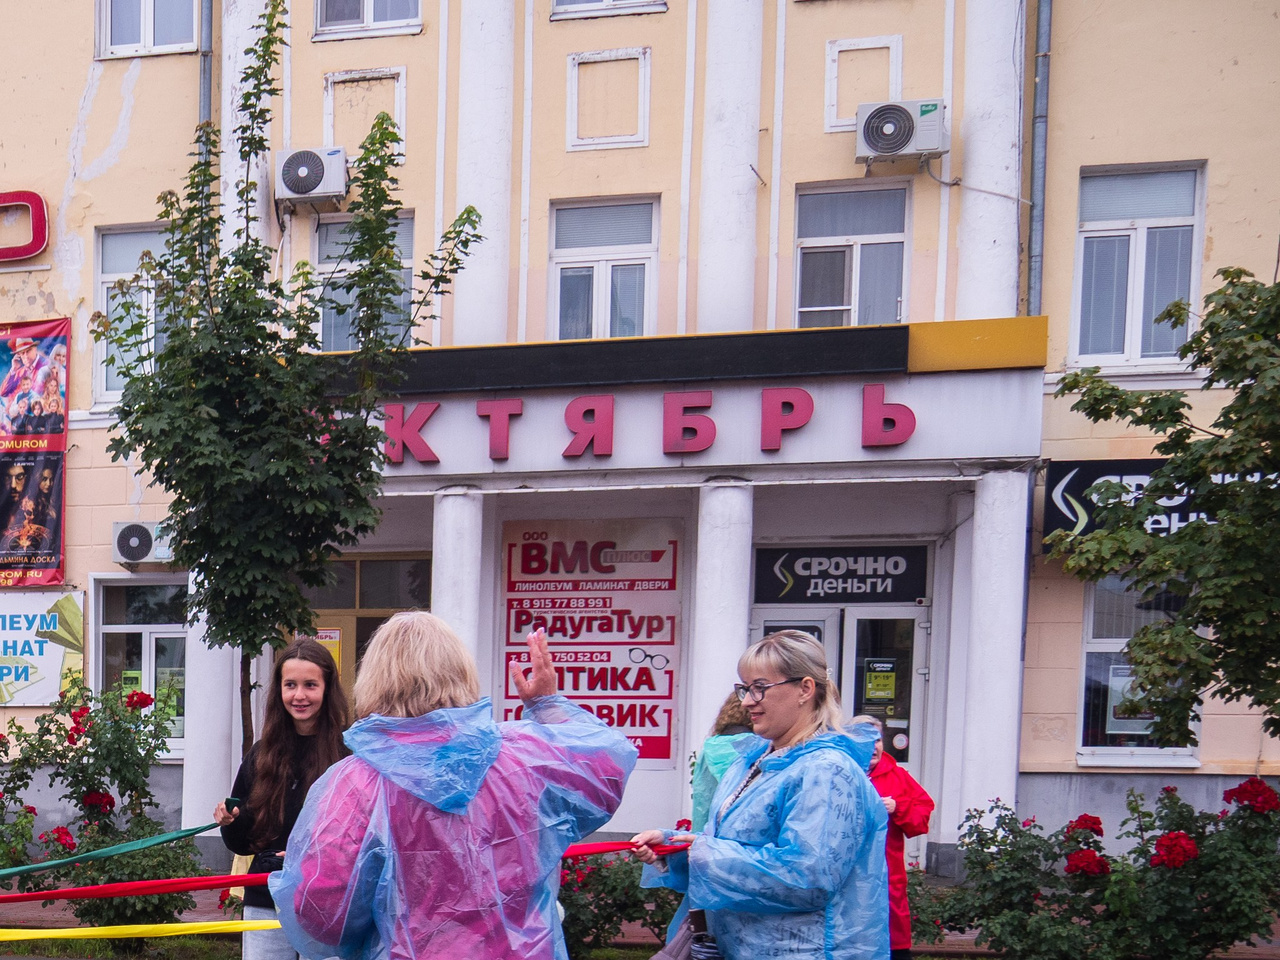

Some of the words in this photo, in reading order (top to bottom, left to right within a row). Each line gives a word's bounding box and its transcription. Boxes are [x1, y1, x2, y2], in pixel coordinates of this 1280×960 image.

[302, 382, 918, 465] КТЯБРЬ
[523, 531, 548, 541] ООО
[521, 540, 617, 574] ВМС
[606, 551, 651, 563] ПЛЮС
[794, 556, 907, 576] СРОЧНО
[514, 582, 573, 591] ЛИНОЛЕУМ
[578, 581, 631, 590] ЛАМИНАТ
[633, 581, 669, 591] ДВЕРИ
[522, 600, 530, 608] 8
[533, 600, 553, 608] 915
[554, 599, 568, 607] 77
[570, 599, 584, 607] 88
[514, 609, 664, 639] РадугаТур
[520, 653, 528, 661] 8
[554, 653, 576, 661] 750
[577, 653, 592, 661] 52
[593, 652, 609, 661] 04
